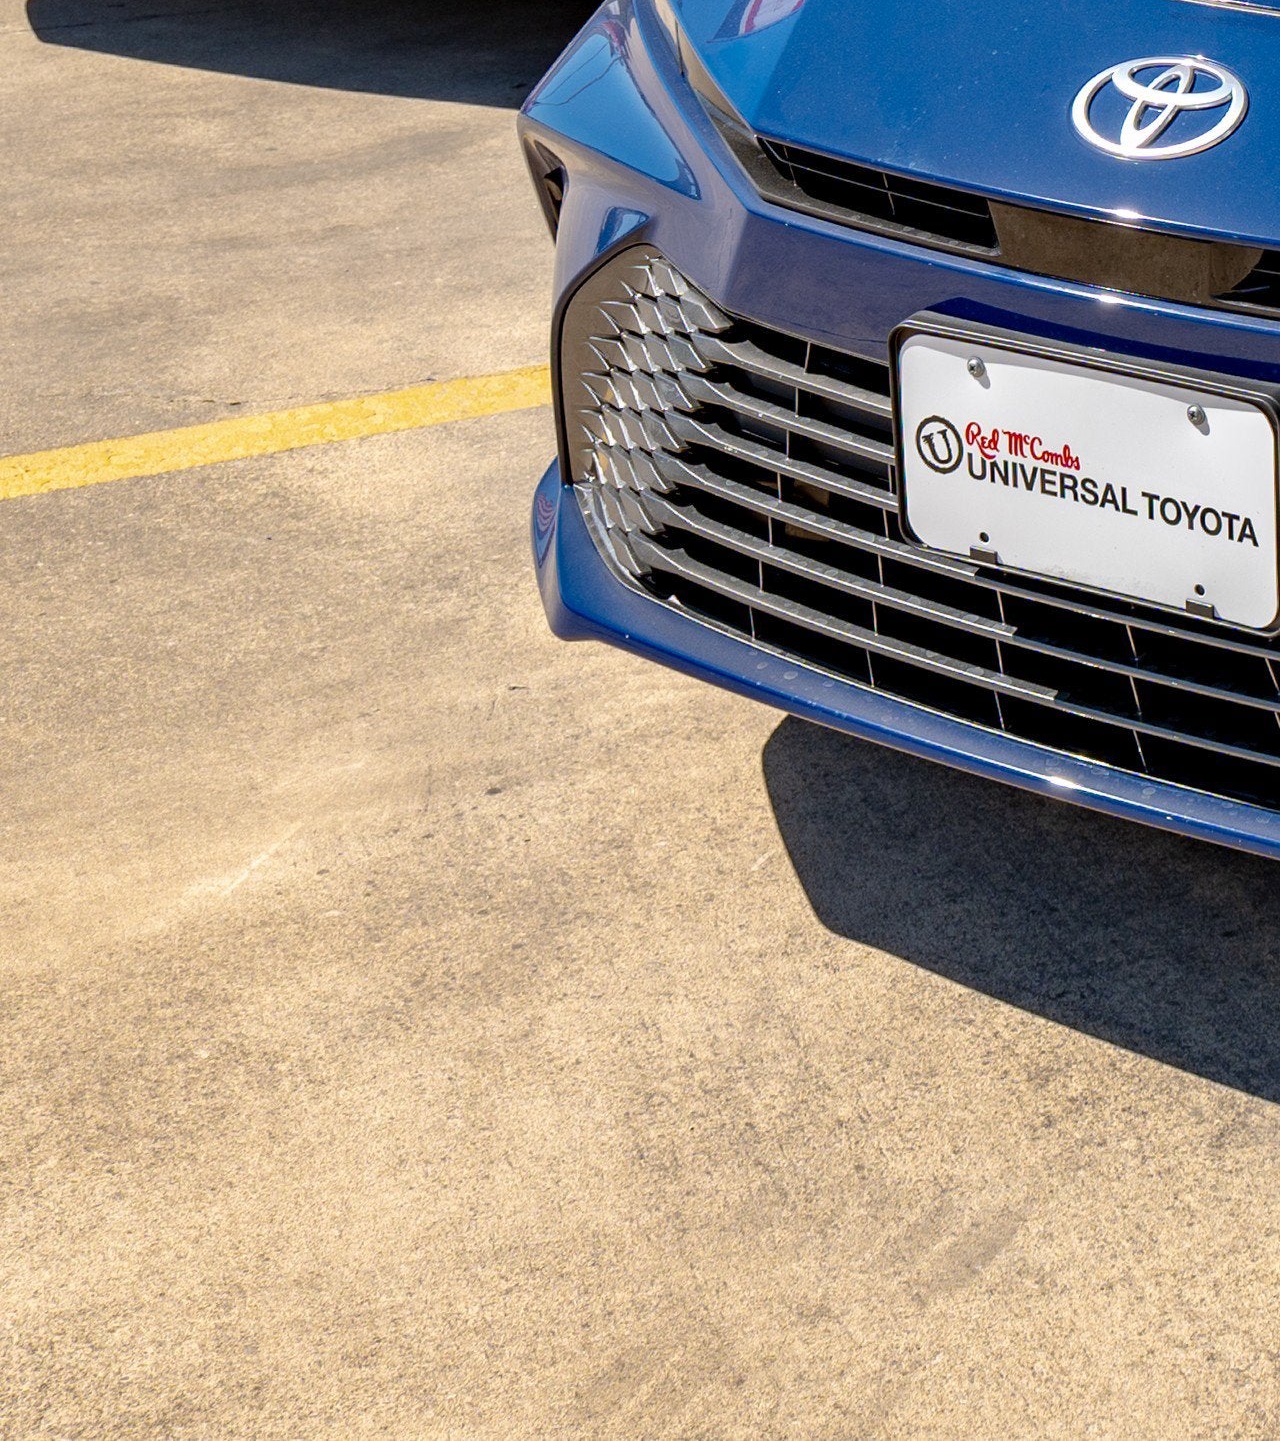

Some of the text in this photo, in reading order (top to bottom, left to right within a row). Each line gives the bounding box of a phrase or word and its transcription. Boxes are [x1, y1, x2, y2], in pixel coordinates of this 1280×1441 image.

[965, 421, 1081, 471] Red McCombs
[967, 452, 1259, 547] UNIVERSAL TOYOTA
